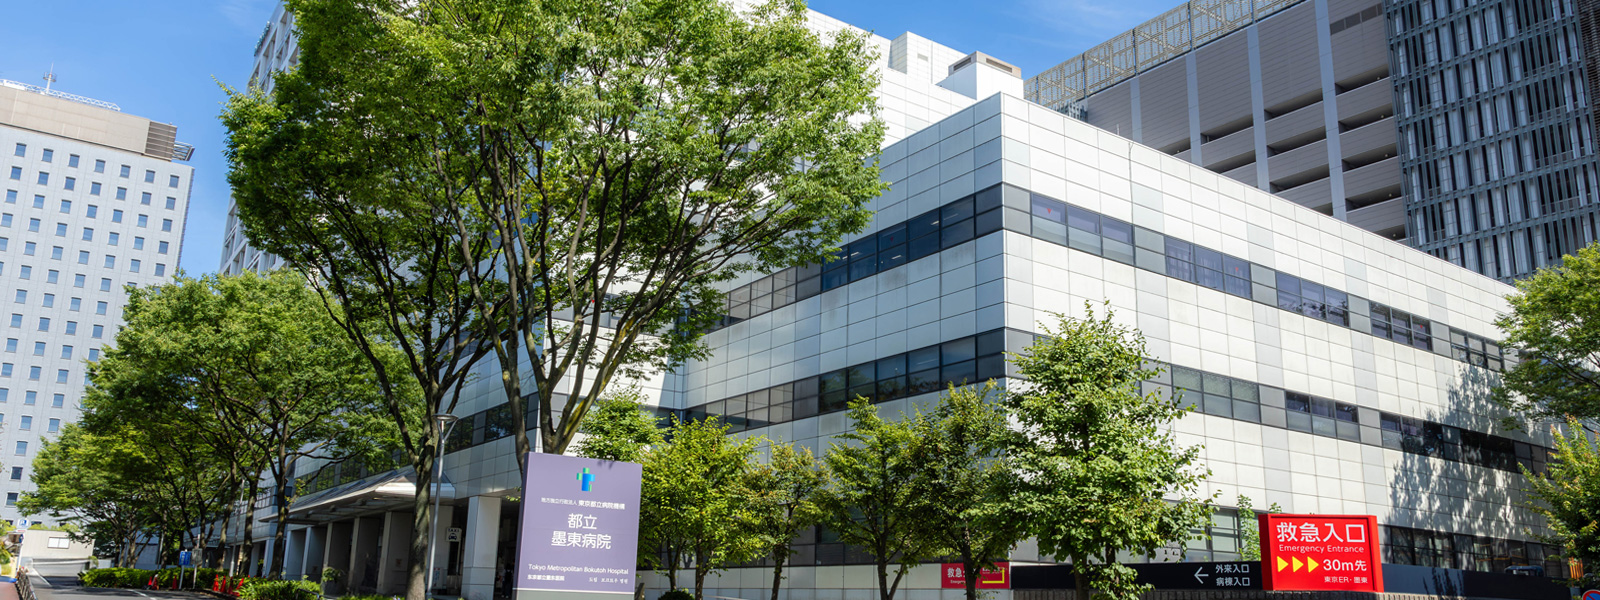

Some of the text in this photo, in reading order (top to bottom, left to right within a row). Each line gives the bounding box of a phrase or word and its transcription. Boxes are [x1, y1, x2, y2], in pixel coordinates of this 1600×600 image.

[568, 513, 597, 530] 都立
[1276, 522, 1365, 543] 救急入口
[551, 530, 611, 549] 墨東病院
[1279, 544, 1364, 554] Emergency Entrance
[528, 563, 546, 571] Tokyo
[547, 565, 583, 573] Metropolitan
[584, 566, 606, 574] Bokutoh
[1215, 564, 1250, 573] 外来入口
[1323, 559, 1367, 572] 30m先
[1215, 577, 1251, 586] 病棟入口
